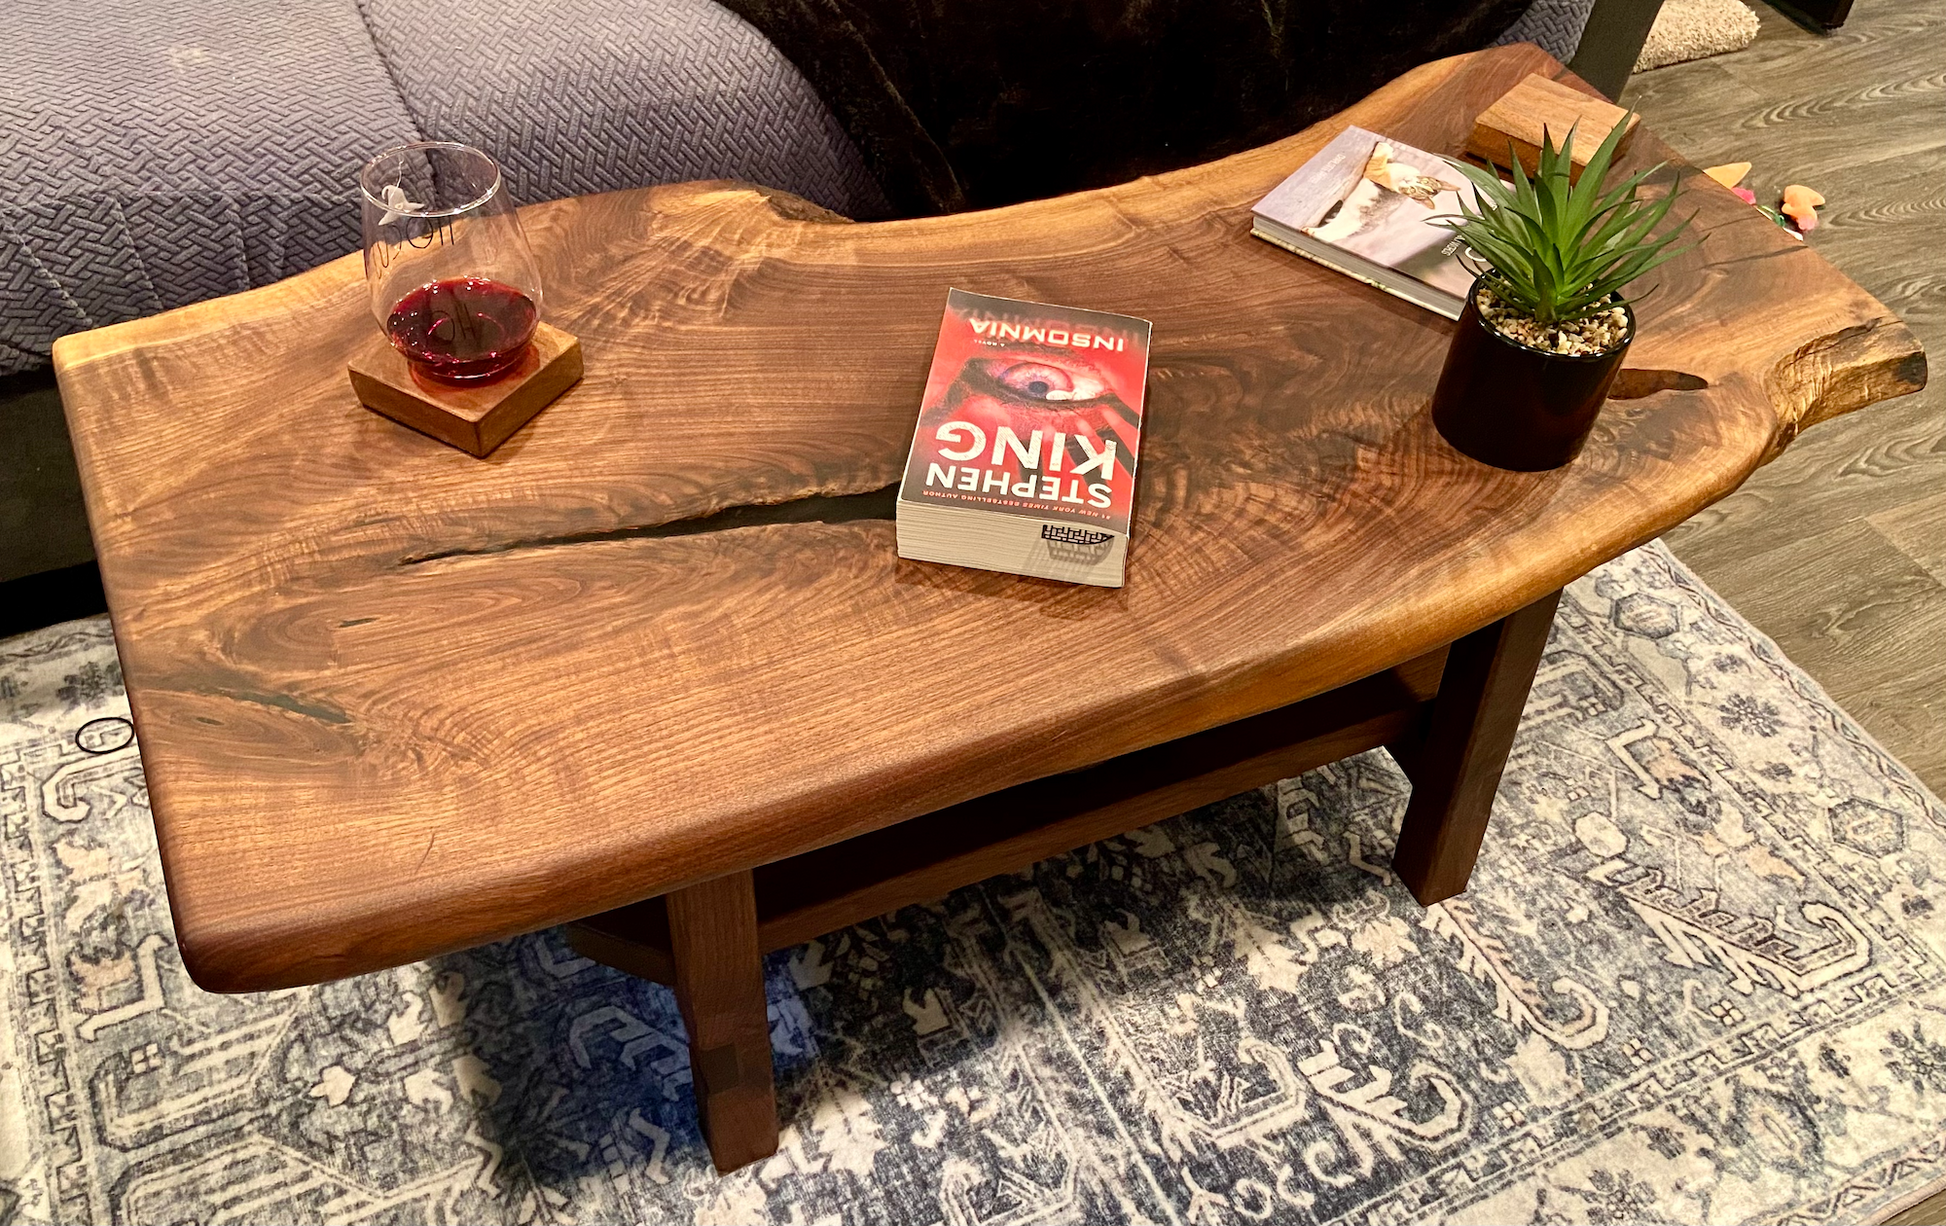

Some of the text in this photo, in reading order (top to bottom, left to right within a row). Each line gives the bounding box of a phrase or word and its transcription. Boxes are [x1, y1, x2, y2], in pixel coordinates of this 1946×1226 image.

[969, 318, 1124, 352] INSOMNIA
[973, 339, 998, 347] NOVEL
[935, 421, 1117, 481] KING
[925, 462, 1112, 509] STEPHEN
[922, 490, 959, 499] AUTHOR
[961, 494, 1020, 507] BESTSELLING
[1022, 502, 1049, 510] TIMES
[1052, 505, 1076, 514] YORK
[1078, 509, 1099, 517] NEW
